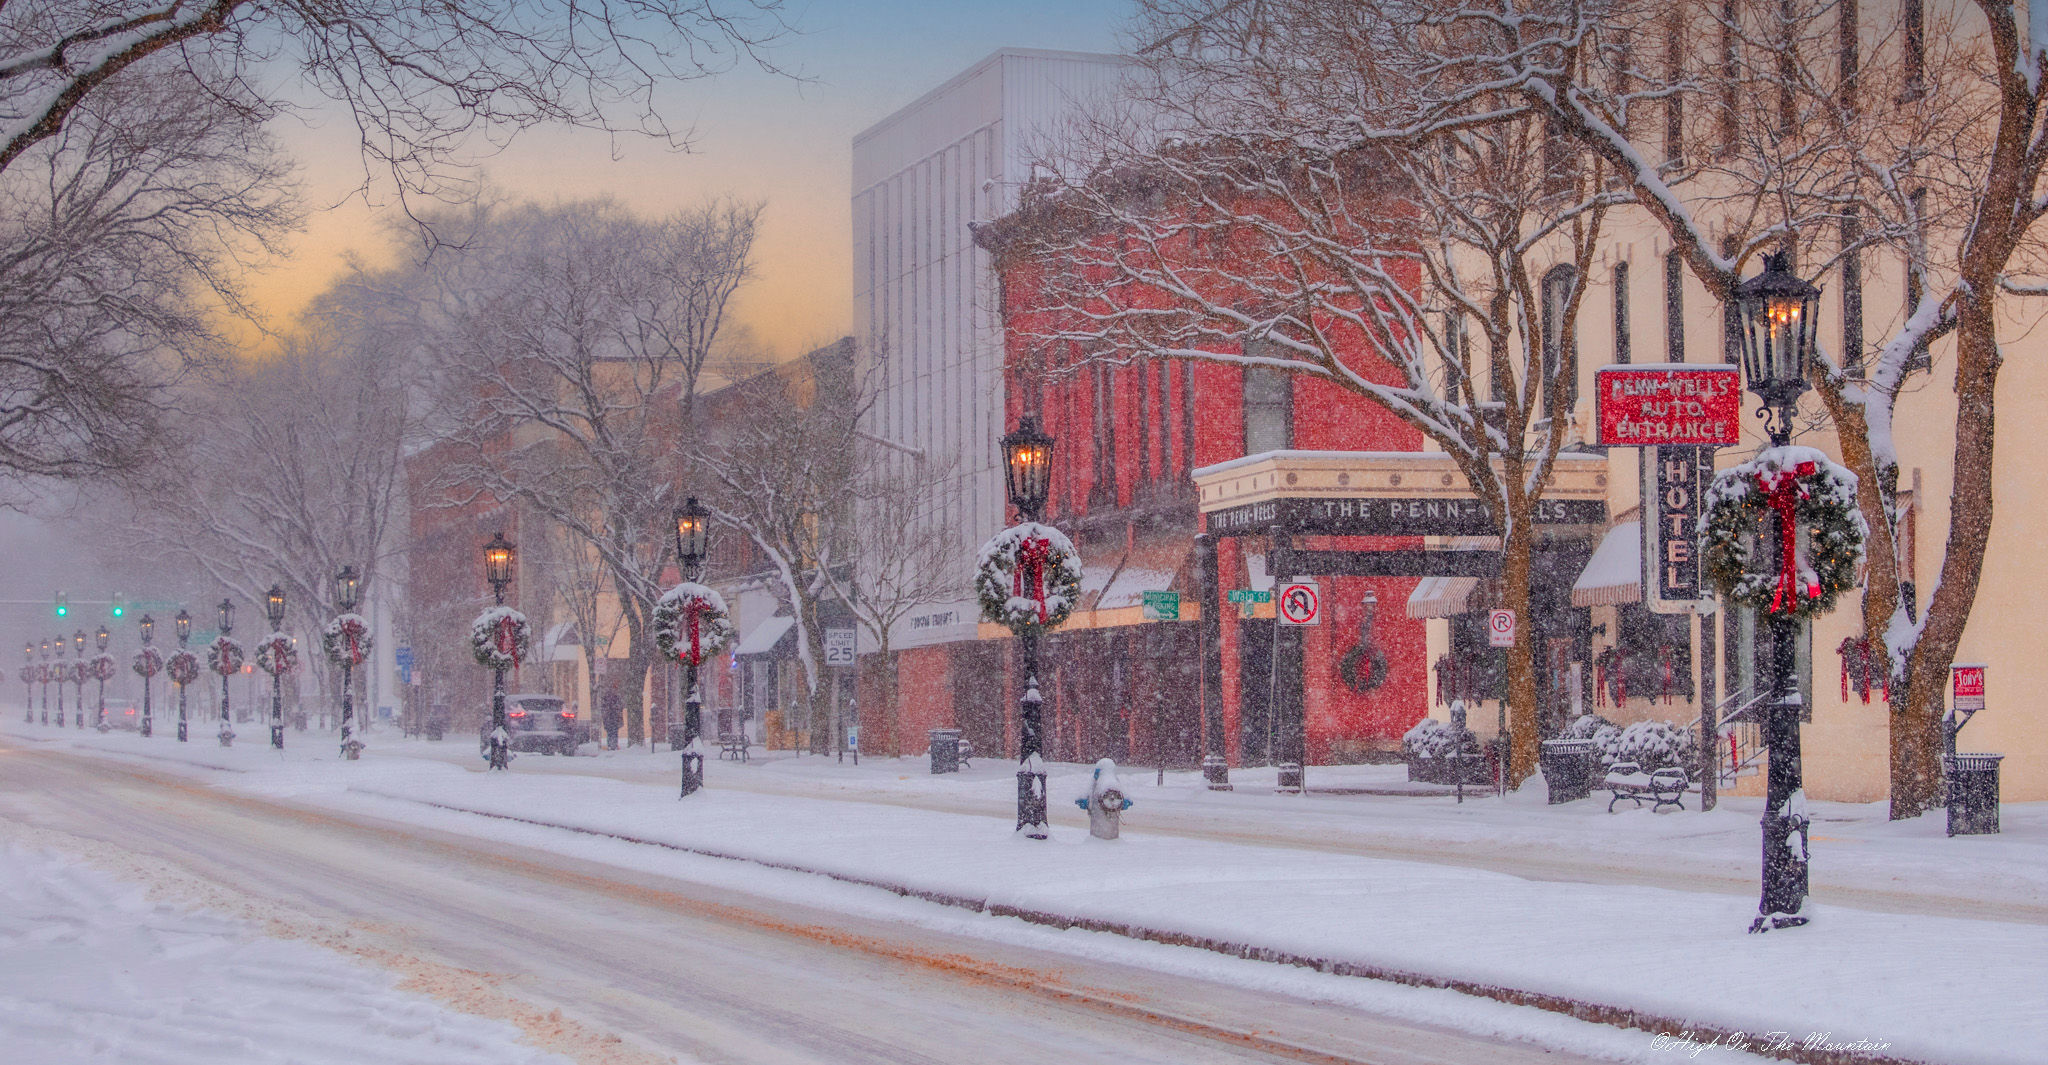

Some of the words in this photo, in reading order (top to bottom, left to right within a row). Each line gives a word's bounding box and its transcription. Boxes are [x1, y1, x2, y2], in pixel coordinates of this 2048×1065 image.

[1641, 401, 1704, 417] AUTO
[1616, 421, 1727, 438] ENTRANCE
[1214, 514, 1227, 528] THE
[1230, 503, 1276, 526] PENN-WELLS
[1324, 502, 1371, 518] THE
[1391, 502, 1566, 518] PENN-LS
[1666, 460, 1690, 588] HOTEL
[829, 647, 853, 661] 25
